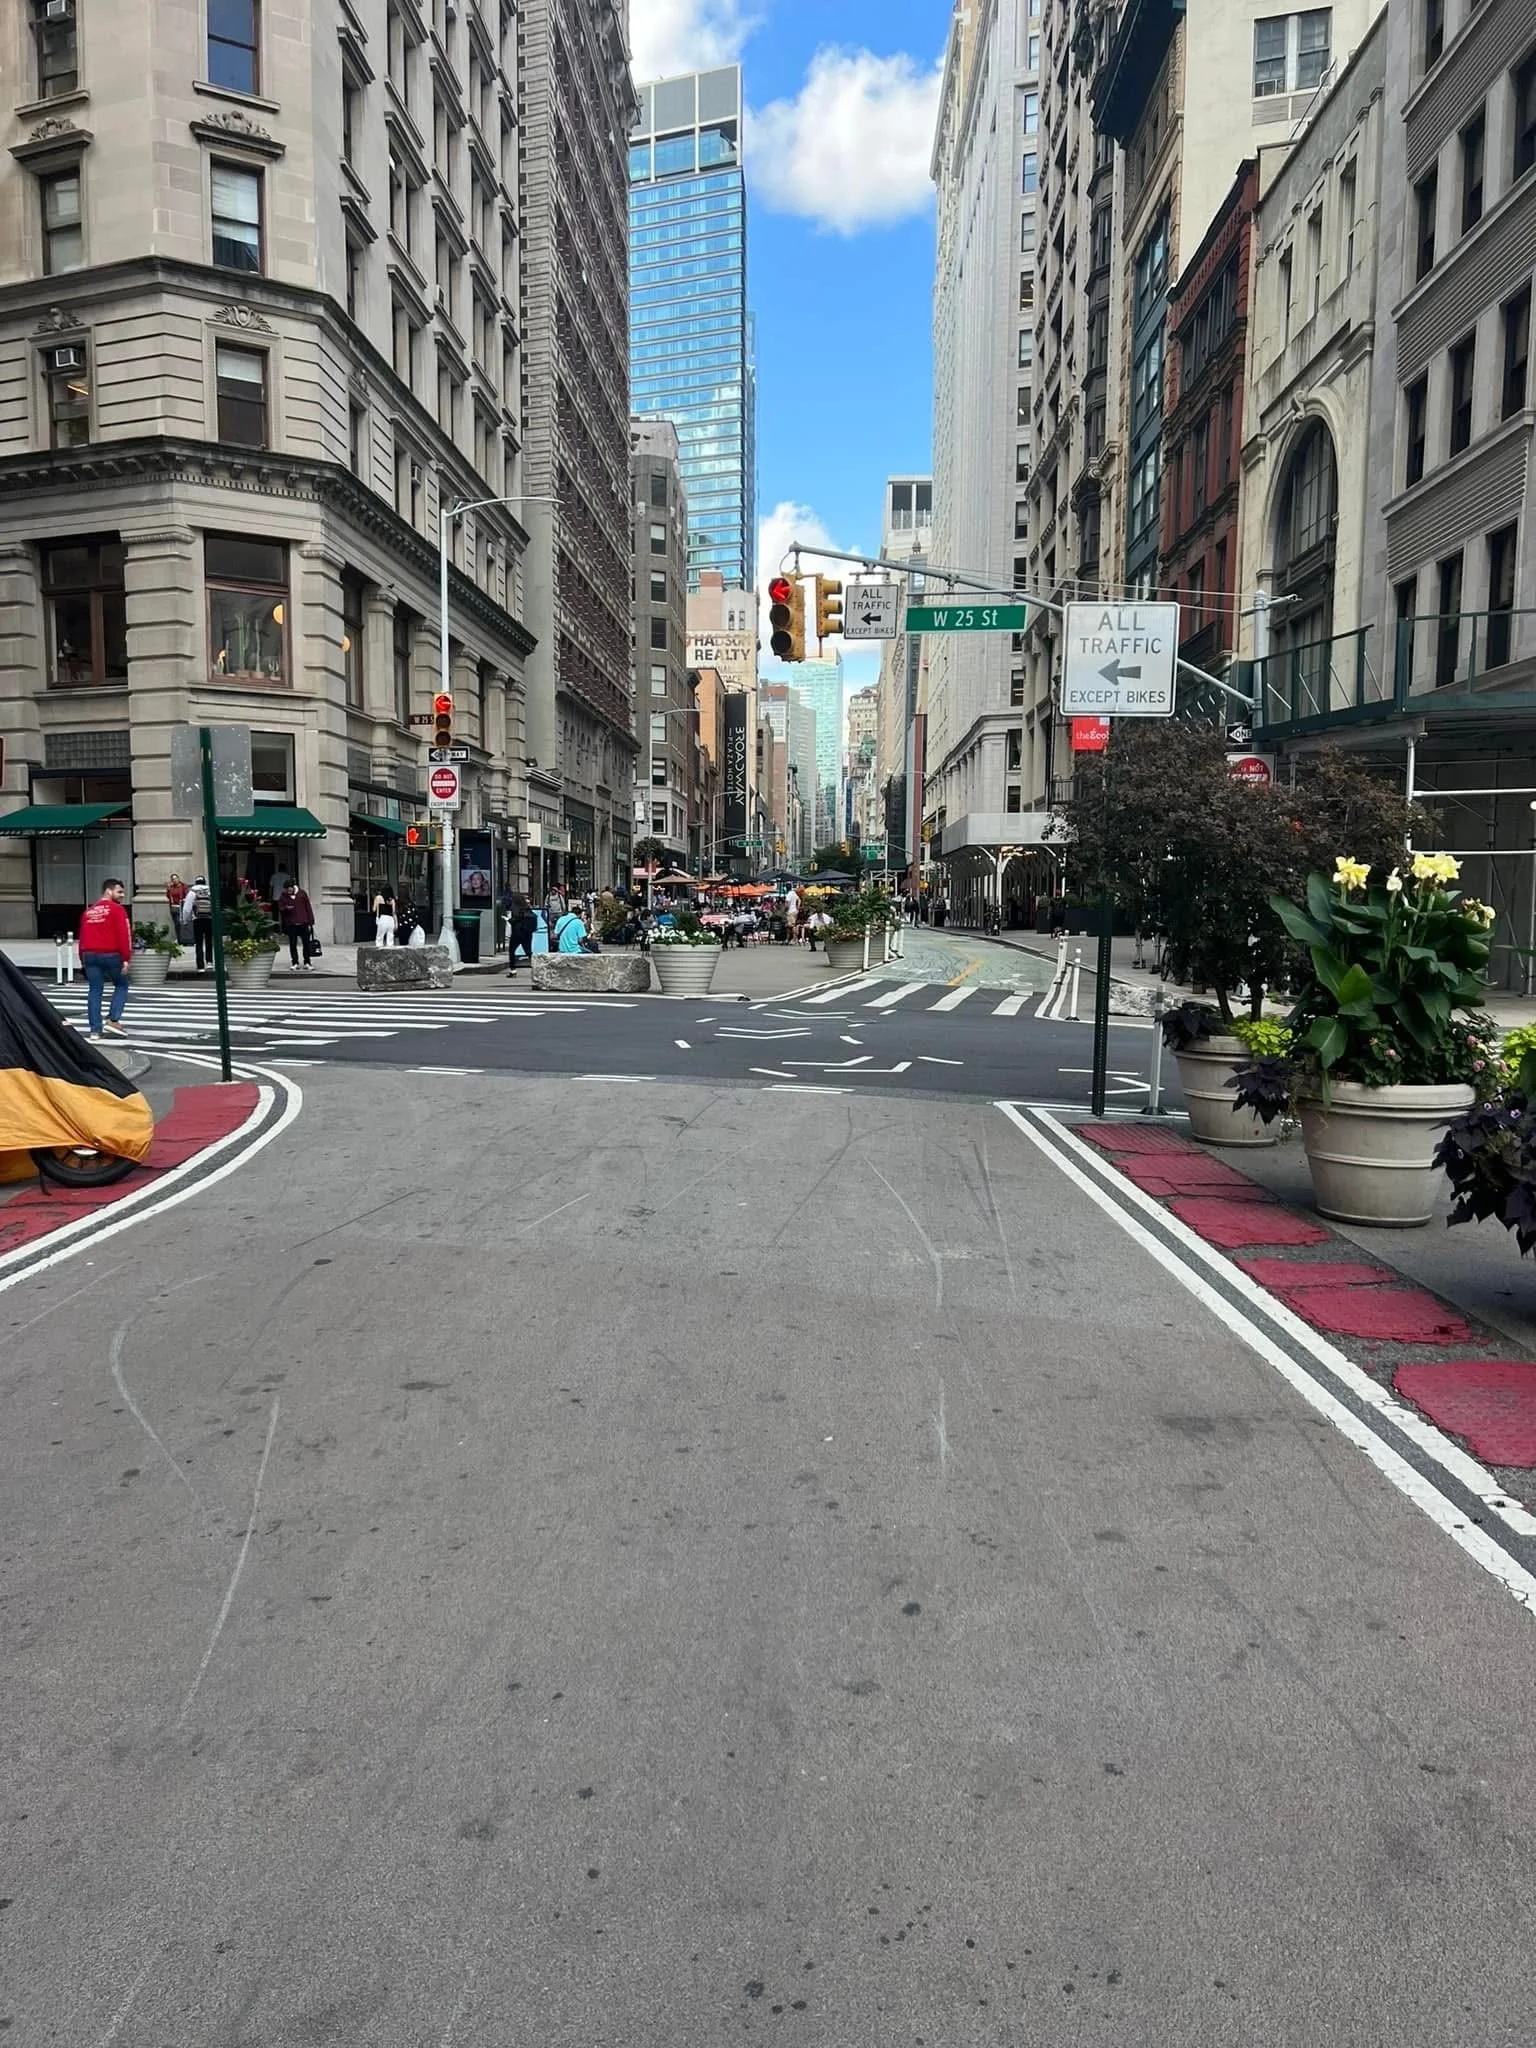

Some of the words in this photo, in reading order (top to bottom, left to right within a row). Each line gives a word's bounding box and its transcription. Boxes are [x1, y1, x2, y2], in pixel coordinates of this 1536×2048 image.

[861, 588, 883, 599] ALL
[852, 601, 892, 610] TRAFFIC
[933, 610, 948, 627] W
[955, 610, 974, 626] 25
[981, 609, 998, 626] St
[1097, 611, 1146, 631] ALL
[846, 627, 871, 635] EXCEPT
[1079, 637, 1162, 654] TRAFFIC
[695, 648, 751, 661] REALTY
[1070, 690, 1121, 704] EXCEPT
[1126, 690, 1166, 704] BIKES
[1233, 729, 1253, 739] ONE
[735, 727, 745, 806] BROADWAY
